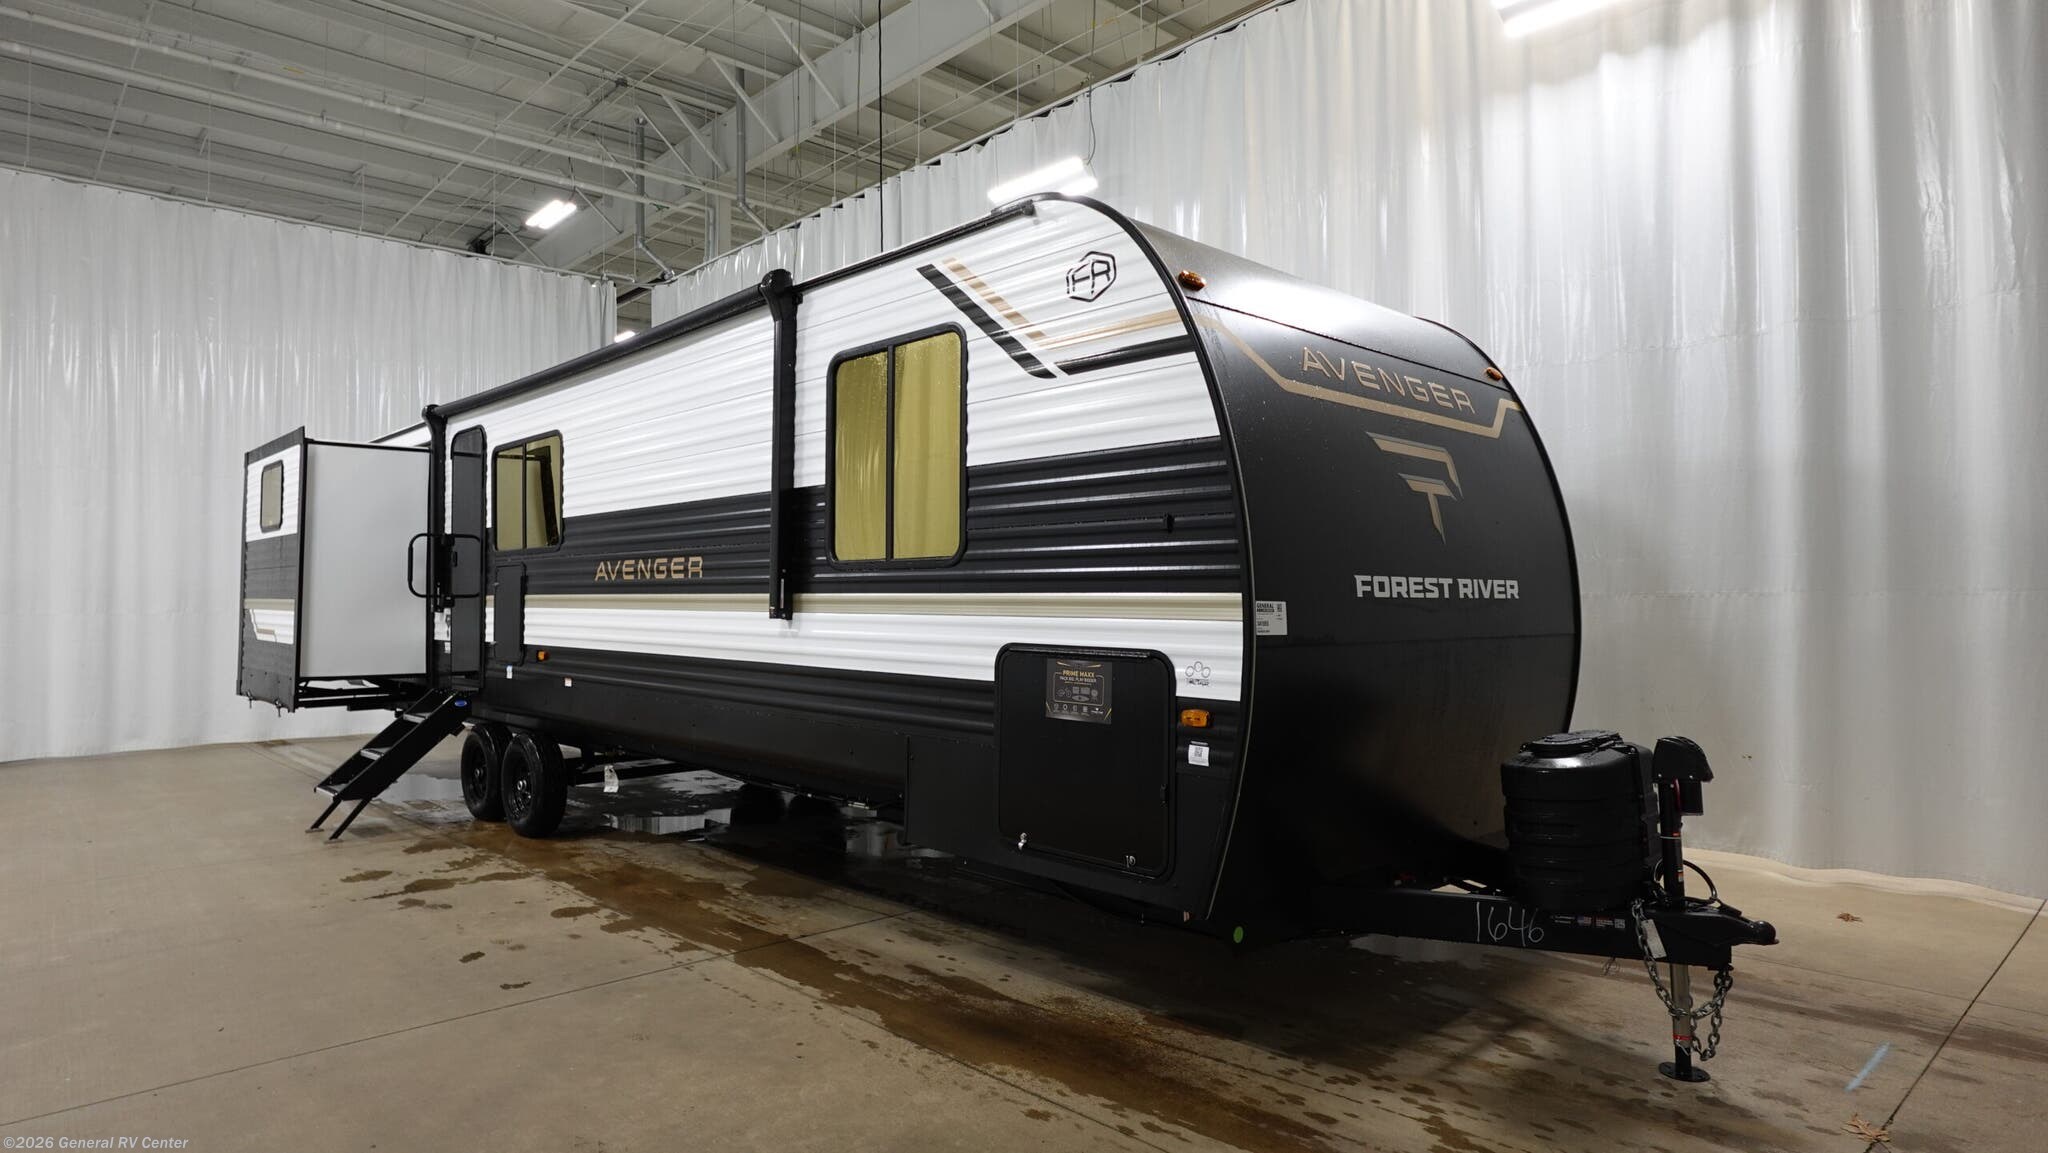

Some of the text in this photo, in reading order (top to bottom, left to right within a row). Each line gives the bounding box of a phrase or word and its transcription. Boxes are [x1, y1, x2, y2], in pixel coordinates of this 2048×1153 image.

[1303, 346, 1476, 414] AVENGER
[594, 556, 703, 581] AVENGER
[1354, 575, 1520, 599] FOREST RIVER
[1476, 901, 1545, 947] 1646
